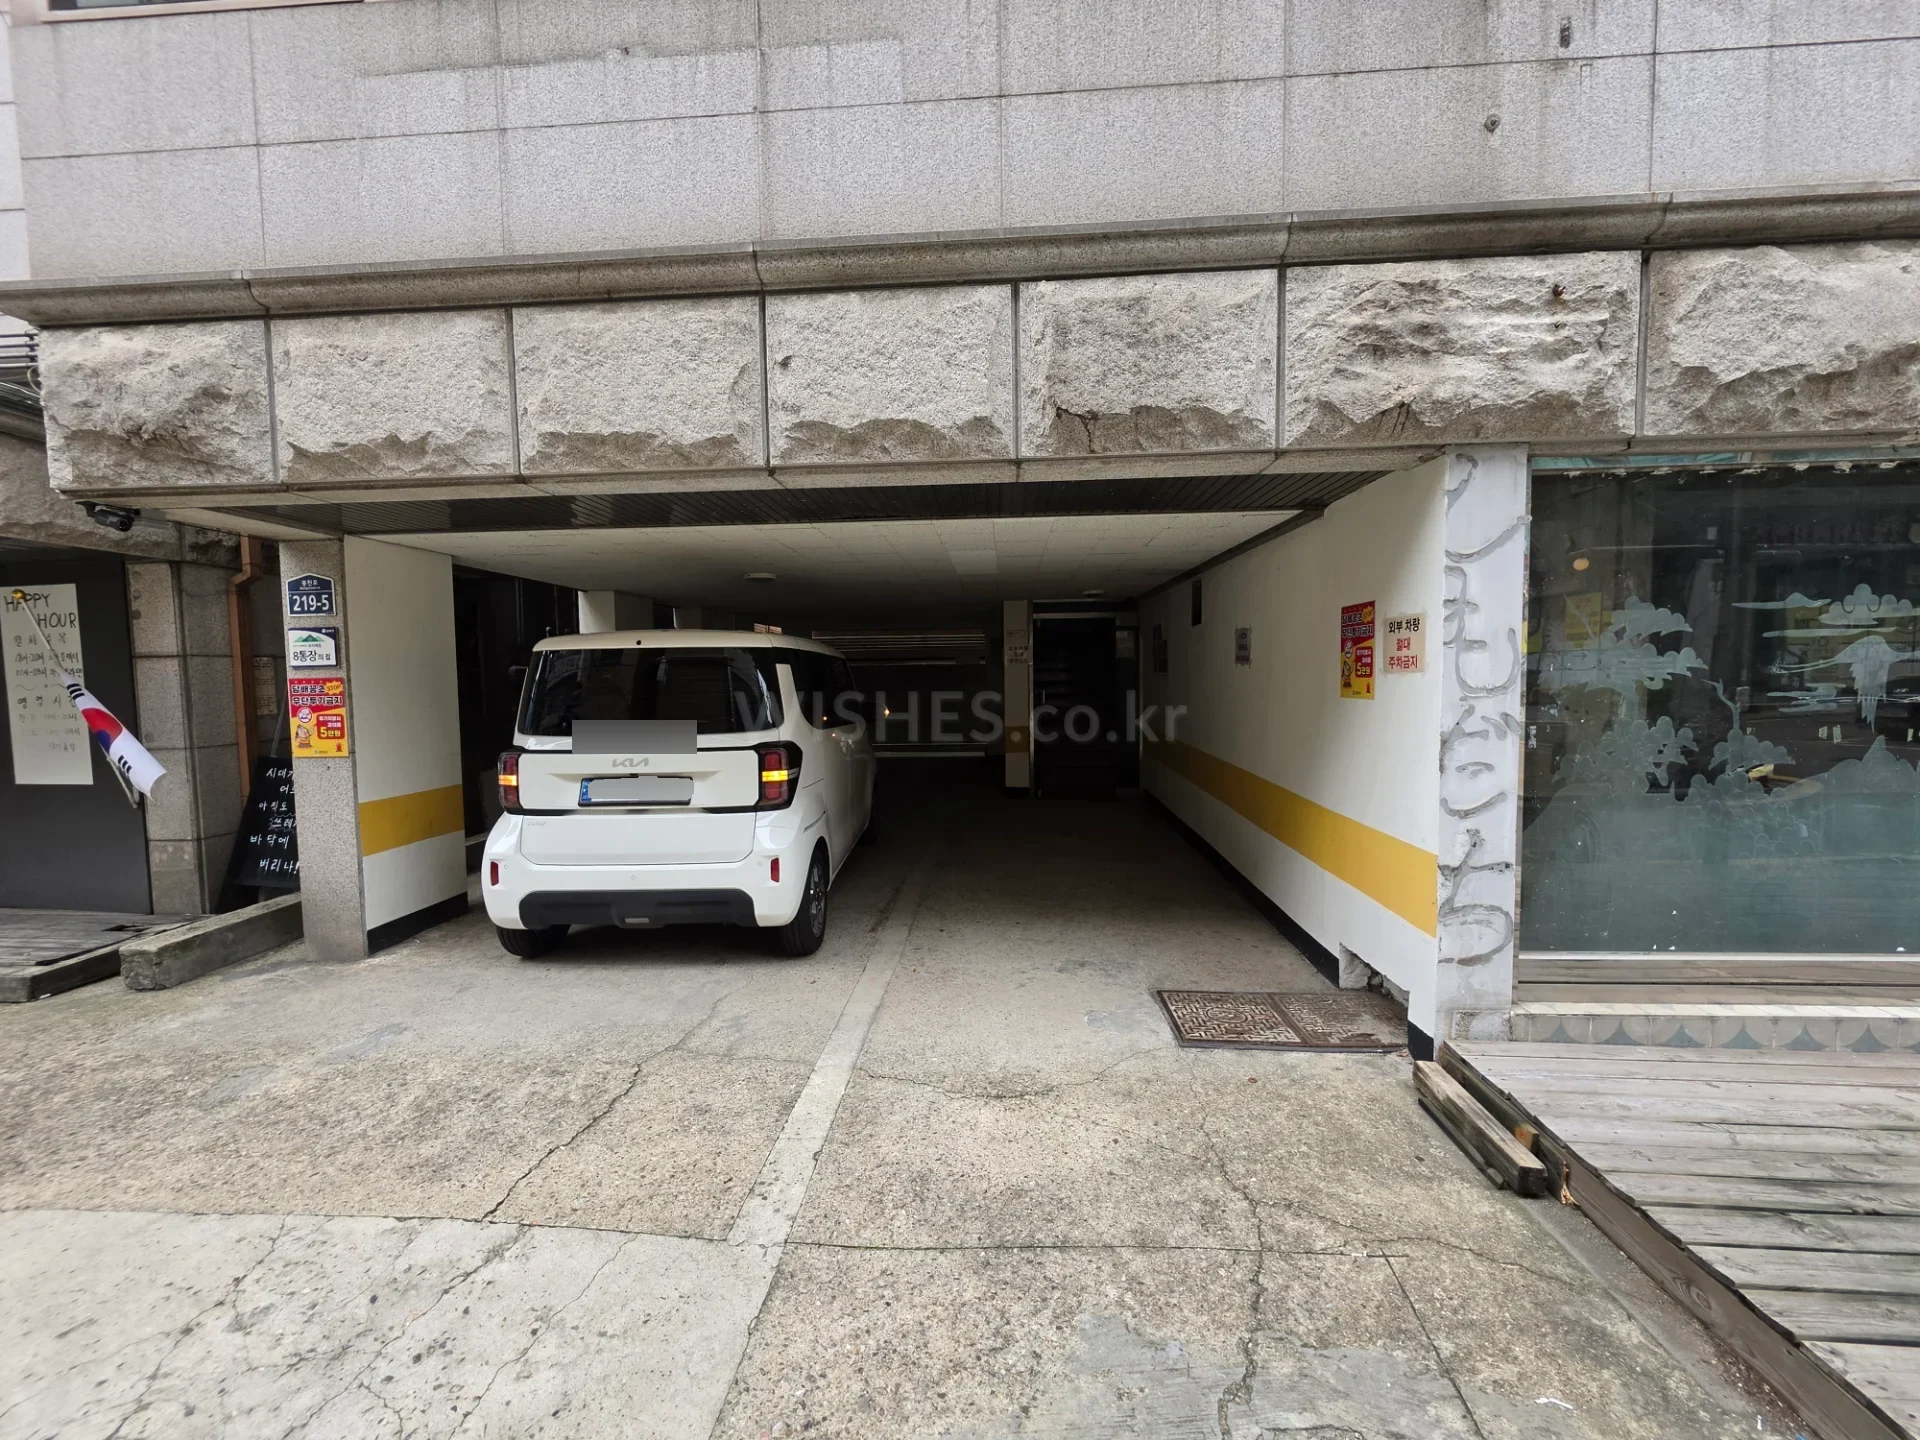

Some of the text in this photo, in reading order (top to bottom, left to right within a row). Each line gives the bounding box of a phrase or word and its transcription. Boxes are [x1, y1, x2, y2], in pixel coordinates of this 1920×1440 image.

[292, 594, 330, 611] 219-5
[37, 612, 77, 629] HOUR
[1388, 617, 1420, 634] 외부 차량
[1396, 636, 1411, 651] 절대
[1388, 655, 1418, 669] 주차금지
[291, 684, 326, 694] 담배꽁초
[326, 683, 342, 692] STOP
[292, 696, 343, 706] 무단투기금지
[320, 727, 341, 737] 5만원
[250, 834, 289, 849] 바닥에
